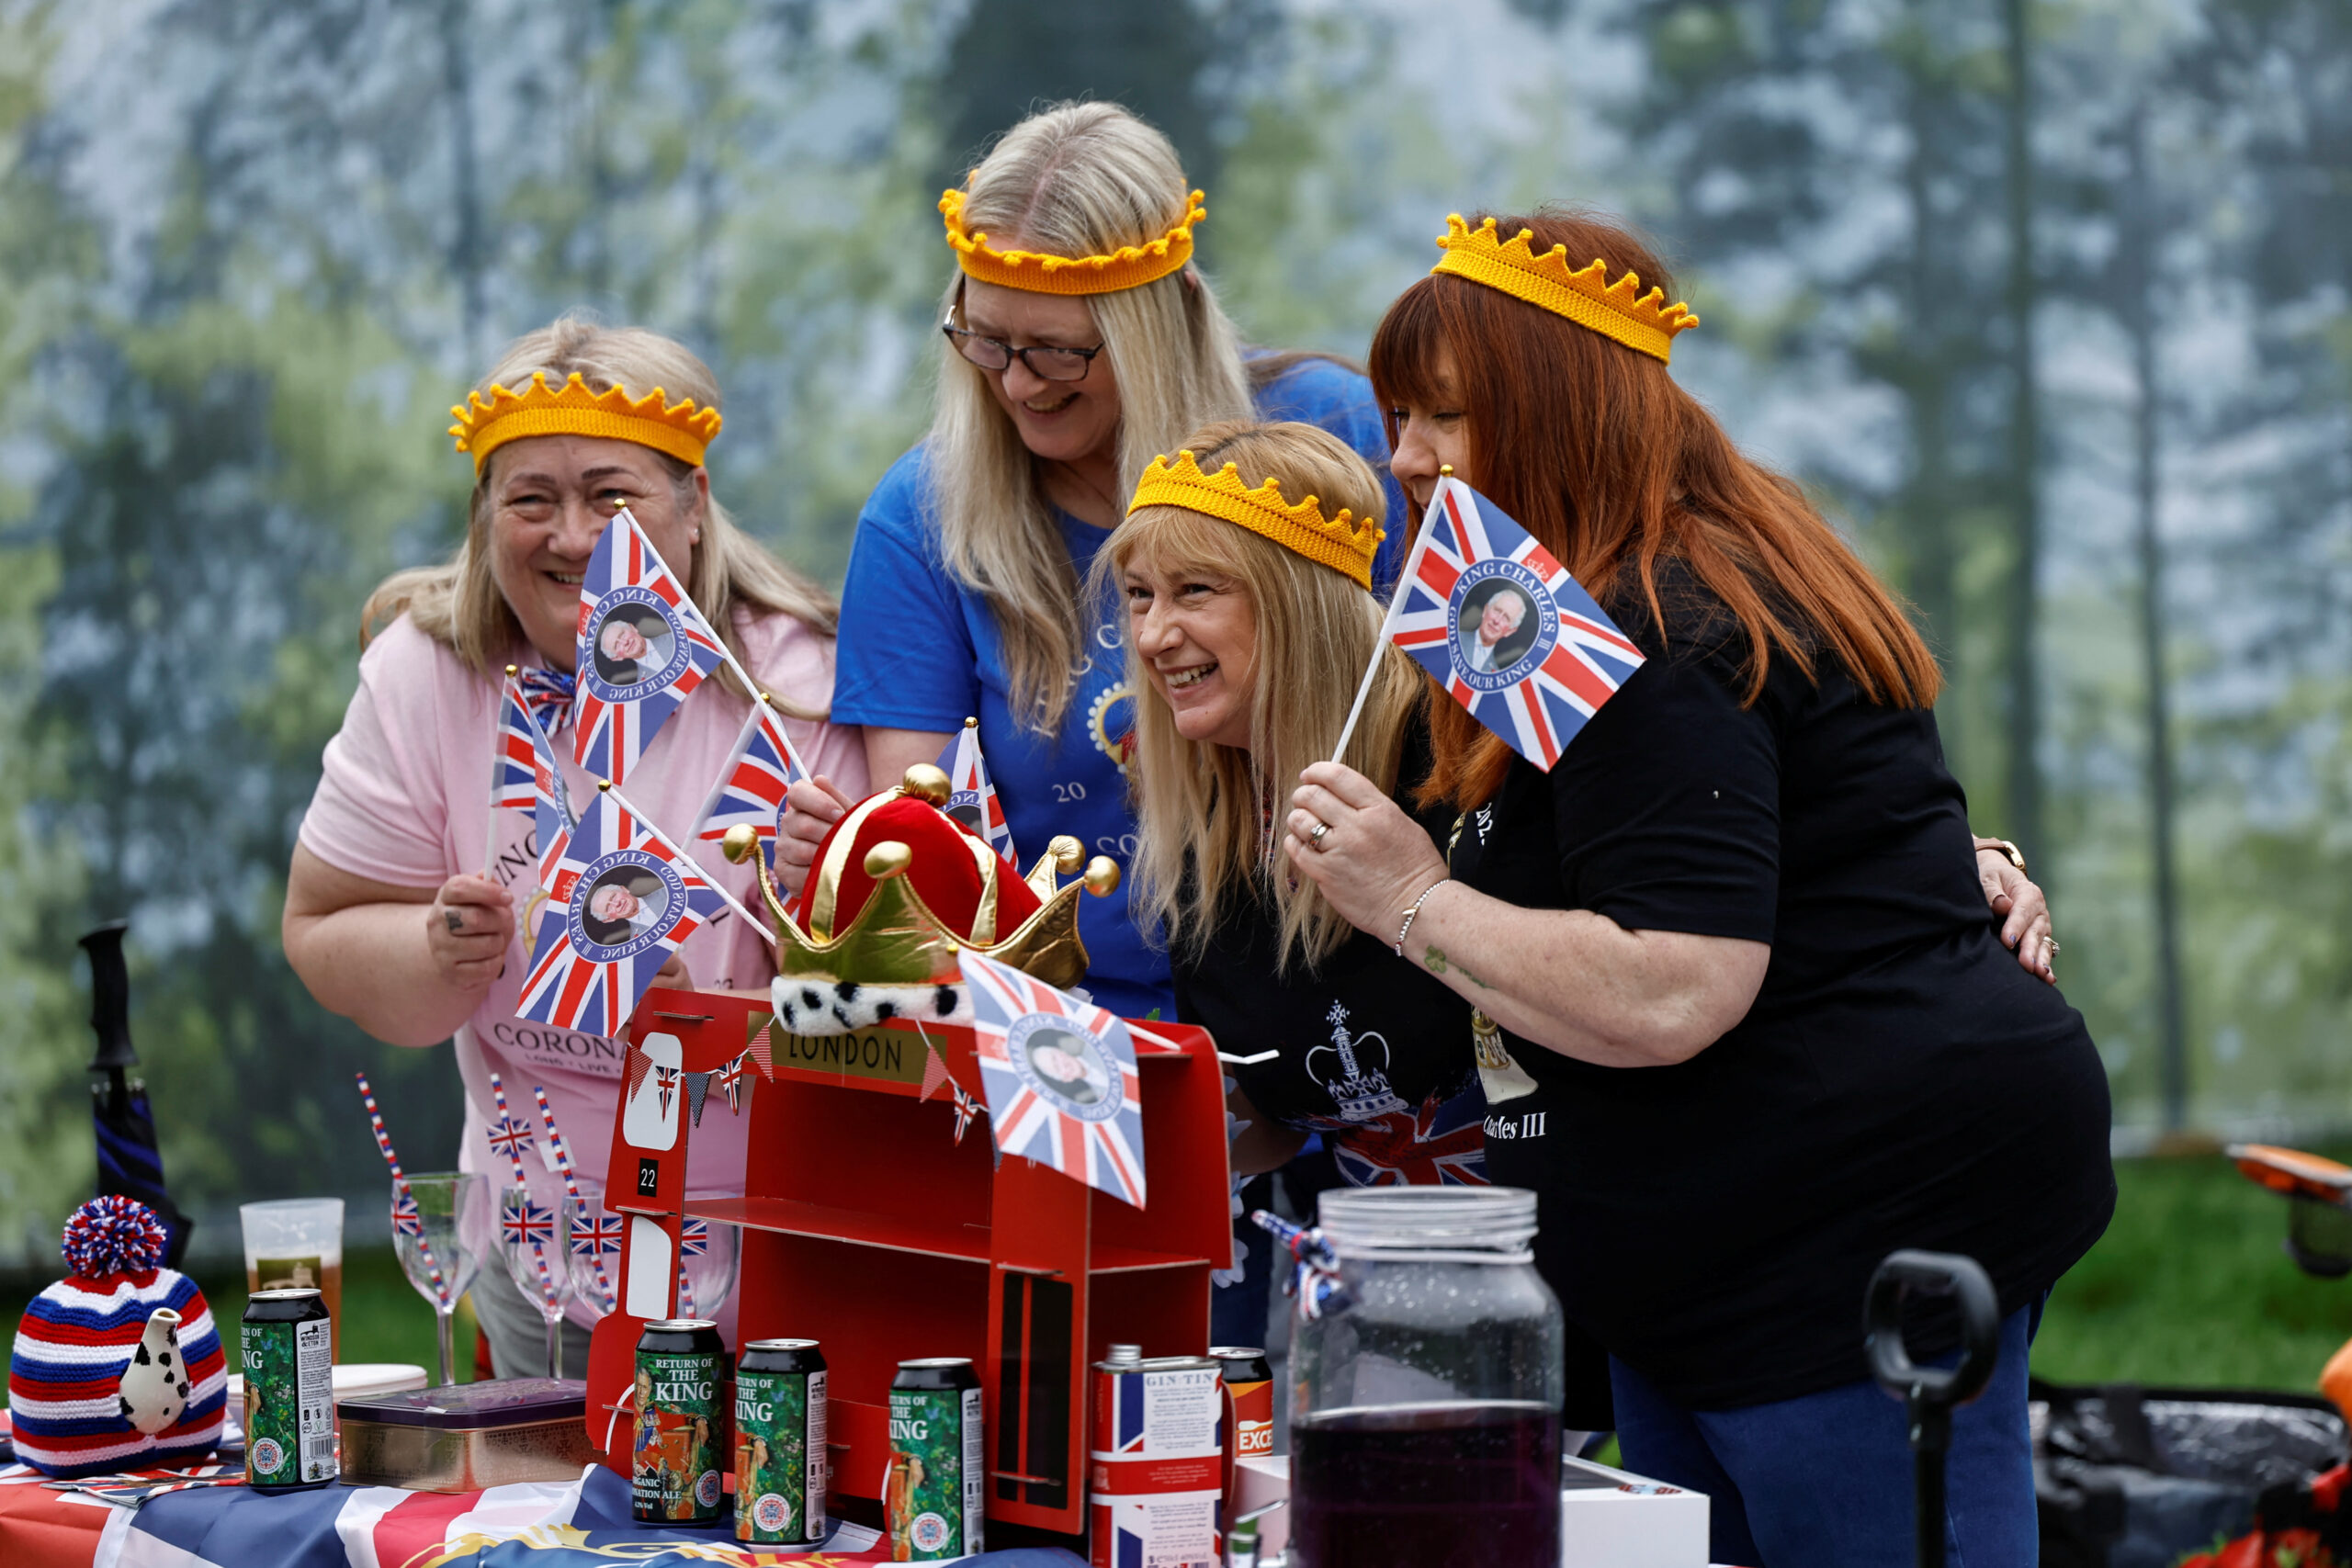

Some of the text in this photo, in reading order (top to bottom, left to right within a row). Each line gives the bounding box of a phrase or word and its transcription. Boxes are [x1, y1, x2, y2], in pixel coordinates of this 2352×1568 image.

[1455, 562, 1556, 650] KING CHARLES III
[1449, 606, 1533, 689] GOD SAVE OUR KING
[789, 1033, 902, 1073] LONDON
[1521, 1111, 1547, 1139] III
[640, 1168, 656, 1188] 22
[251, 1327, 263, 1337] OF
[655, 1358, 714, 1369] RETURN OF
[669, 1370, 699, 1382] THE
[1146, 1373, 1214, 1387] GIN TIN
[759, 1379, 775, 1389] OF
[655, 1382, 714, 1402] KING
[738, 1387, 757, 1400] THE
[912, 1396, 928, 1406] OF
[892, 1405, 912, 1419] THE
[662, 1491, 682, 1499] ALE
